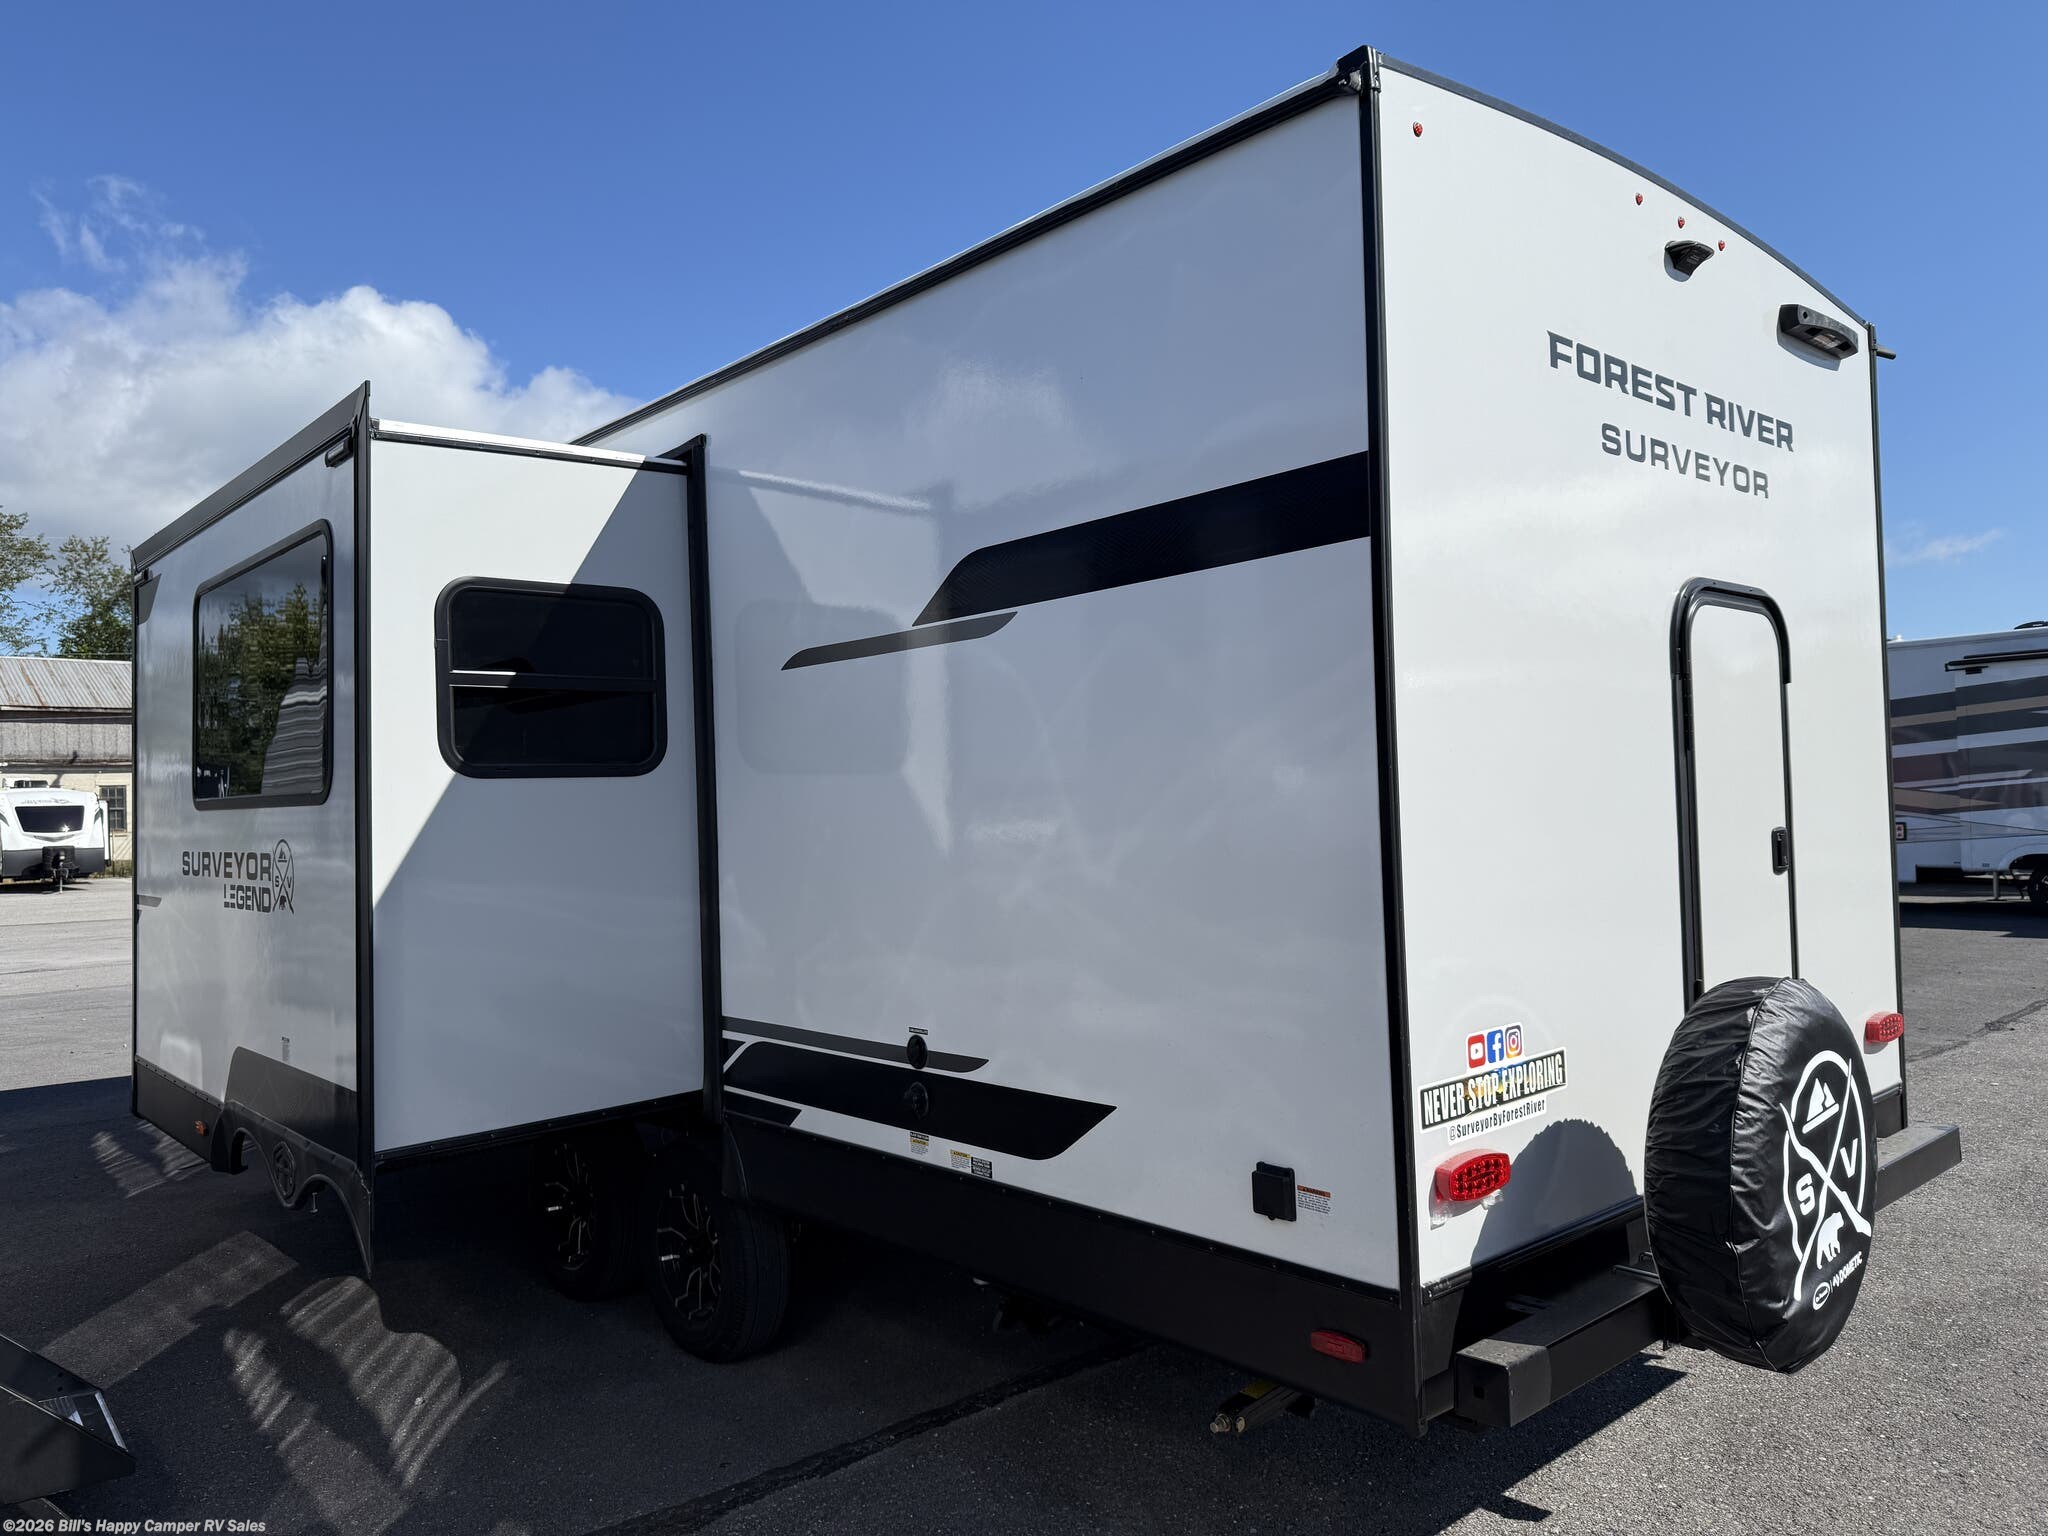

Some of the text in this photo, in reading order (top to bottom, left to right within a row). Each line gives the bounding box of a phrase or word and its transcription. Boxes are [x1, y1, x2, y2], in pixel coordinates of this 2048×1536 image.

[1546, 330, 1794, 452] FOREST RIVER
[1601, 422, 1769, 499] SURVEYOR
[182, 851, 272, 881] SURVEYOR
[223, 883, 272, 913] LEGEND
[1423, 1053, 1564, 1126] NEVER STOP EXPLORING
[1450, 1099, 1546, 1141] @SurveyorByForestRiver
[1840, 1137, 1858, 1178] V
[1796, 1172, 1816, 1216] S
